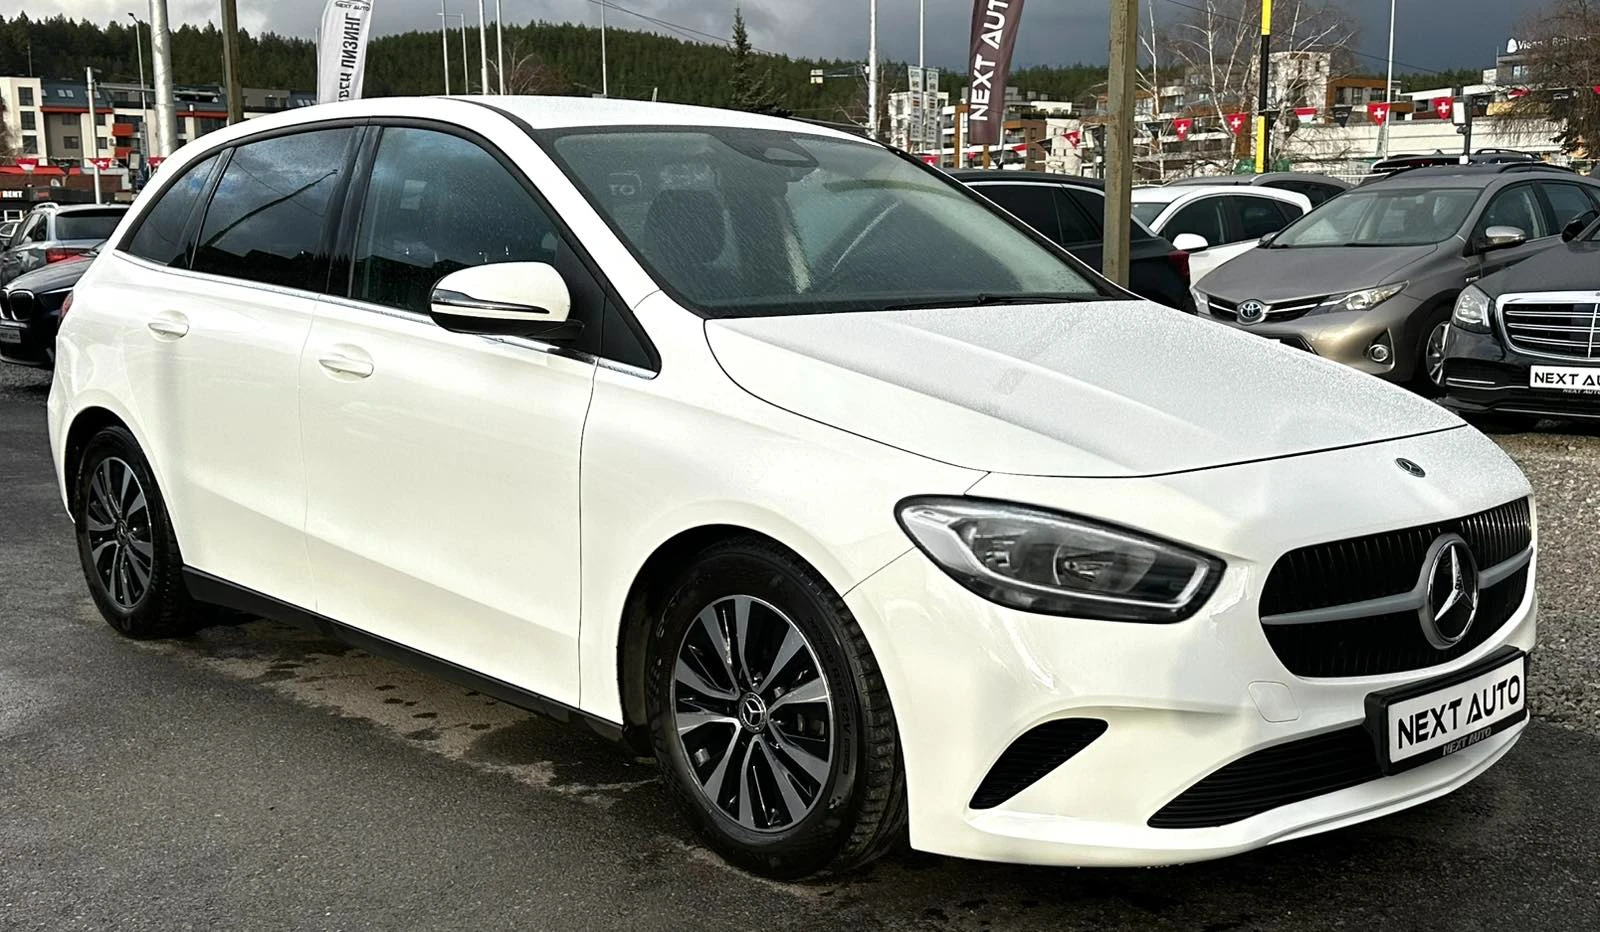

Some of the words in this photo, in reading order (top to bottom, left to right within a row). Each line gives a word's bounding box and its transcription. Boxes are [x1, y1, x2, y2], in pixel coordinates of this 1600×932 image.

[341, 13, 361, 69] ЛИЗИНГ
[969, 54, 996, 120] NEXT
[1534, 371, 1579, 385] NEXT
[1398, 697, 1462, 749] NEXT
[1466, 675, 1521, 725] AUTO
[1442, 736, 1469, 756] NEXT
[1468, 726, 1492, 745] AUTO
